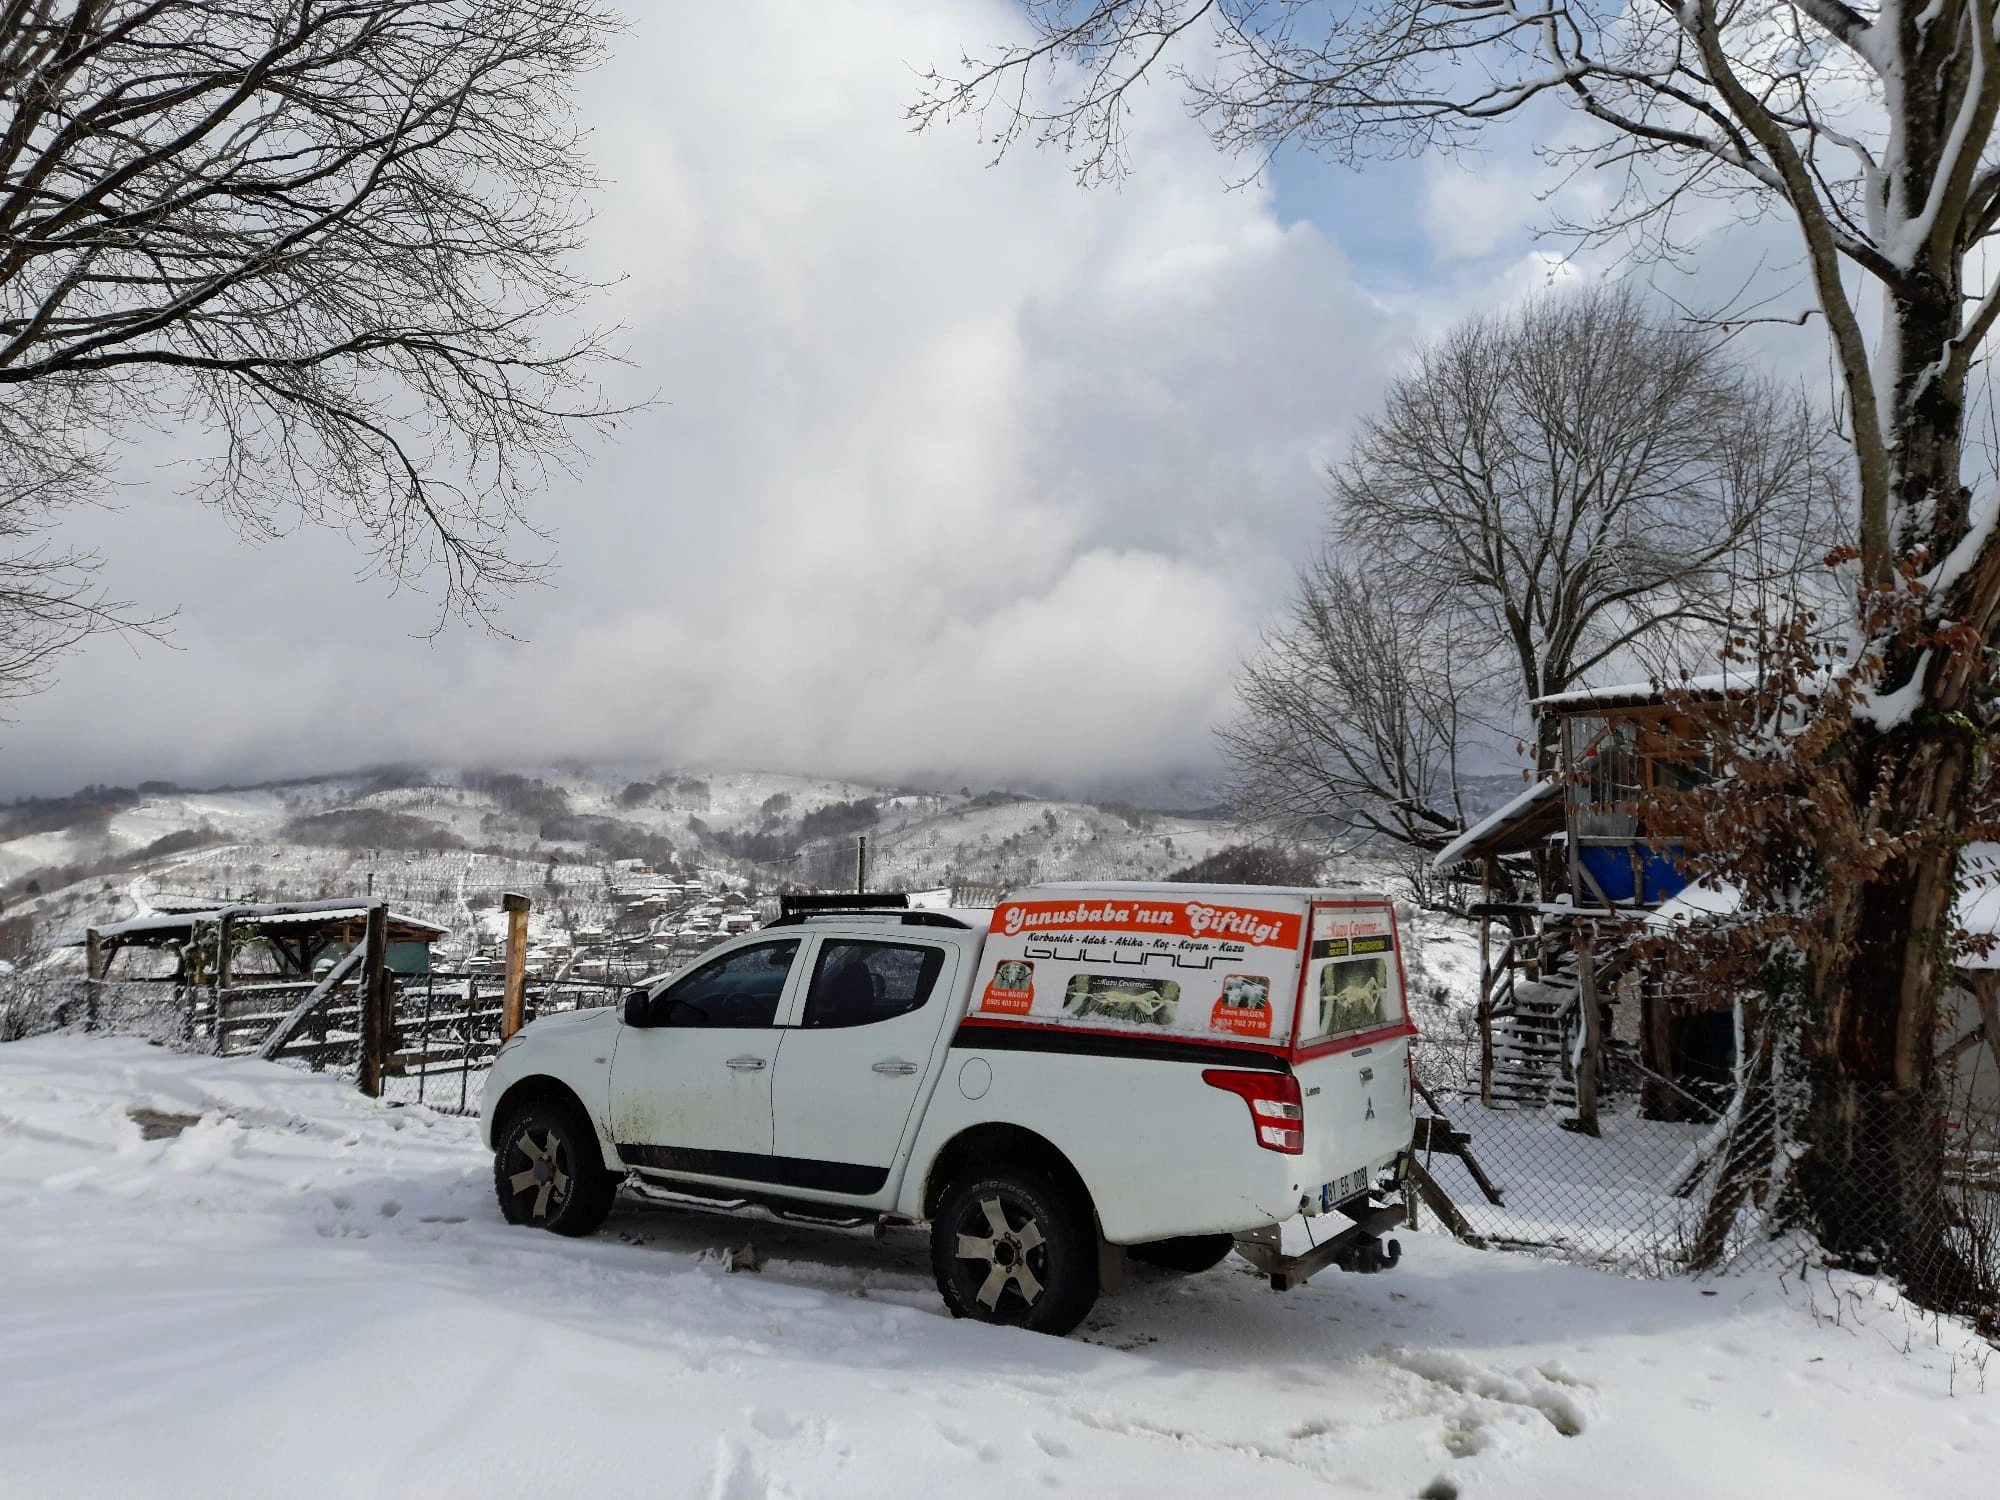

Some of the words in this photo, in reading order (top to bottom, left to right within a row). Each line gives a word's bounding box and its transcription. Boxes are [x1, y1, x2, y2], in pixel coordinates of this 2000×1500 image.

[1005, 903, 1175, 934] Yunusbaba'nın
[1081, 935, 1107, 945] Adak
[1115, 937, 1144, 947] Akika
[1153, 939, 1170, 951] Koç
[1178, 940, 1209, 952] Koyun
[1219, 942, 1245, 953] Kuzu
